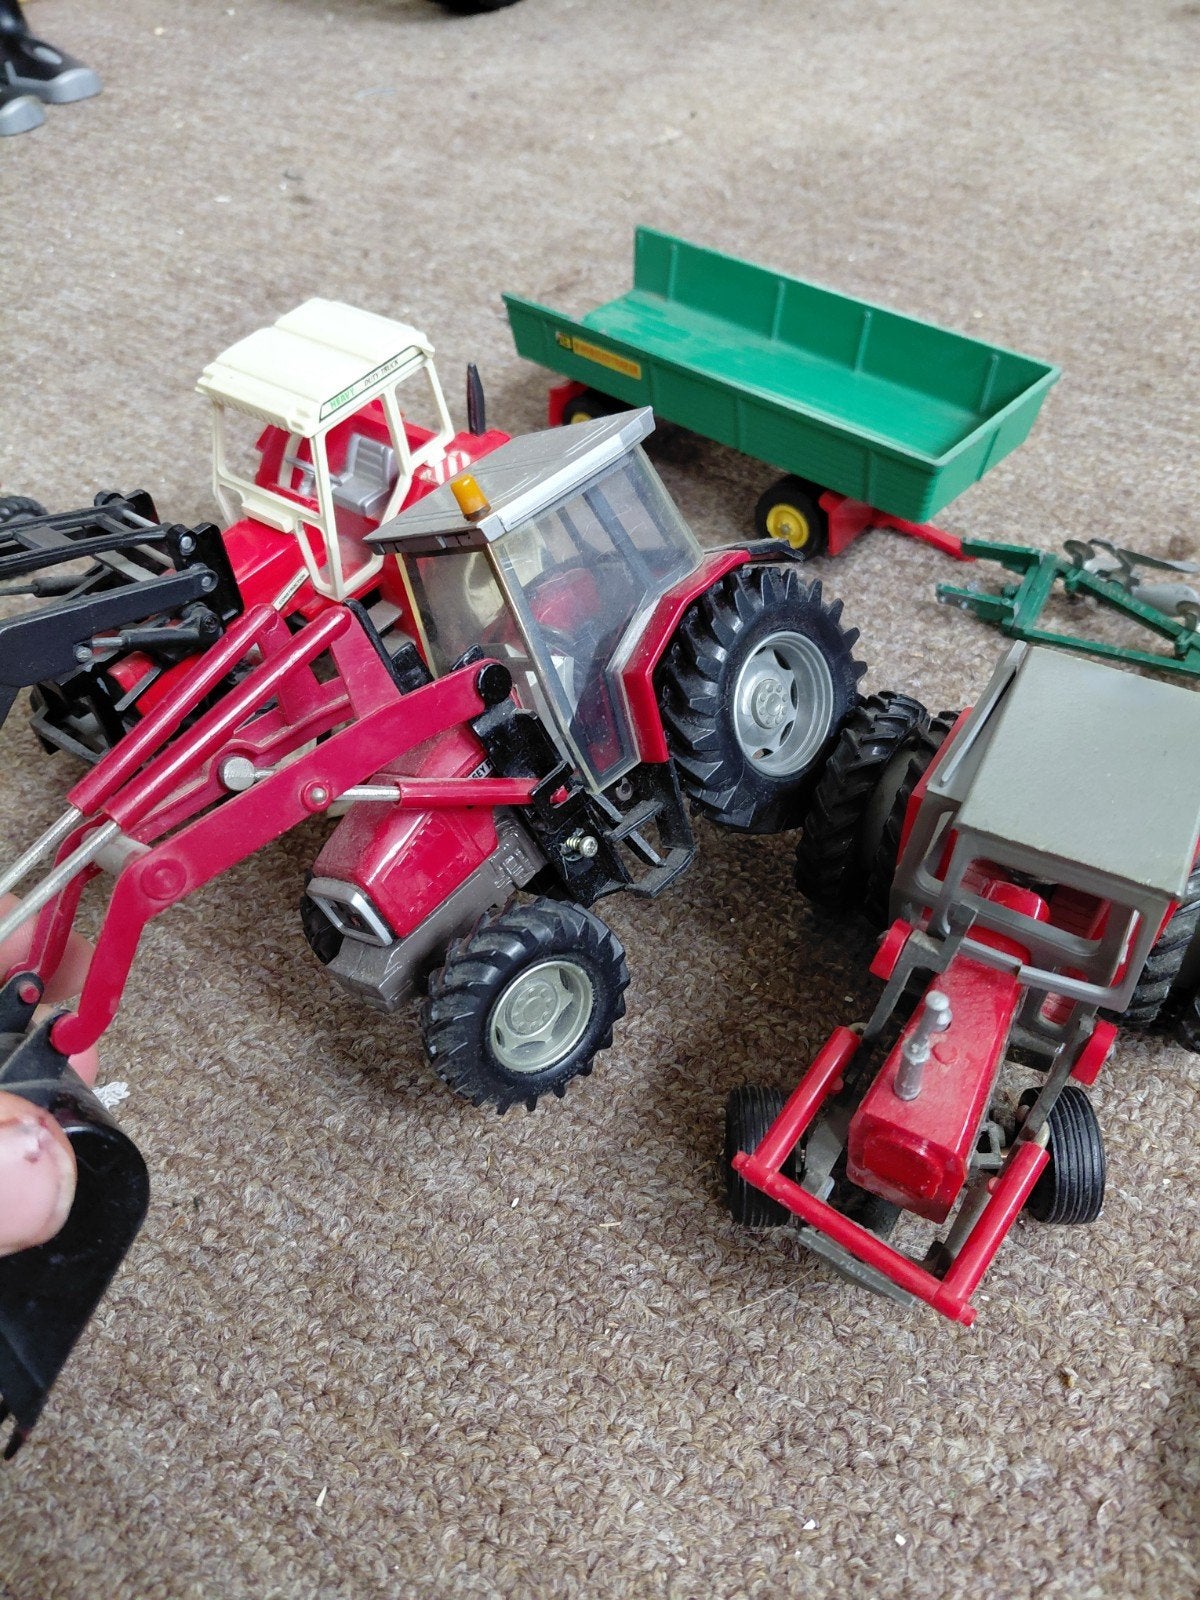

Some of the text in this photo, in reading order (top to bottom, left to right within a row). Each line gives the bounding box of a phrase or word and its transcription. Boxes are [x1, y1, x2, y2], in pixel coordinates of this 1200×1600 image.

[329, 359, 399, 410] HEAVY DUTY TRUCK
